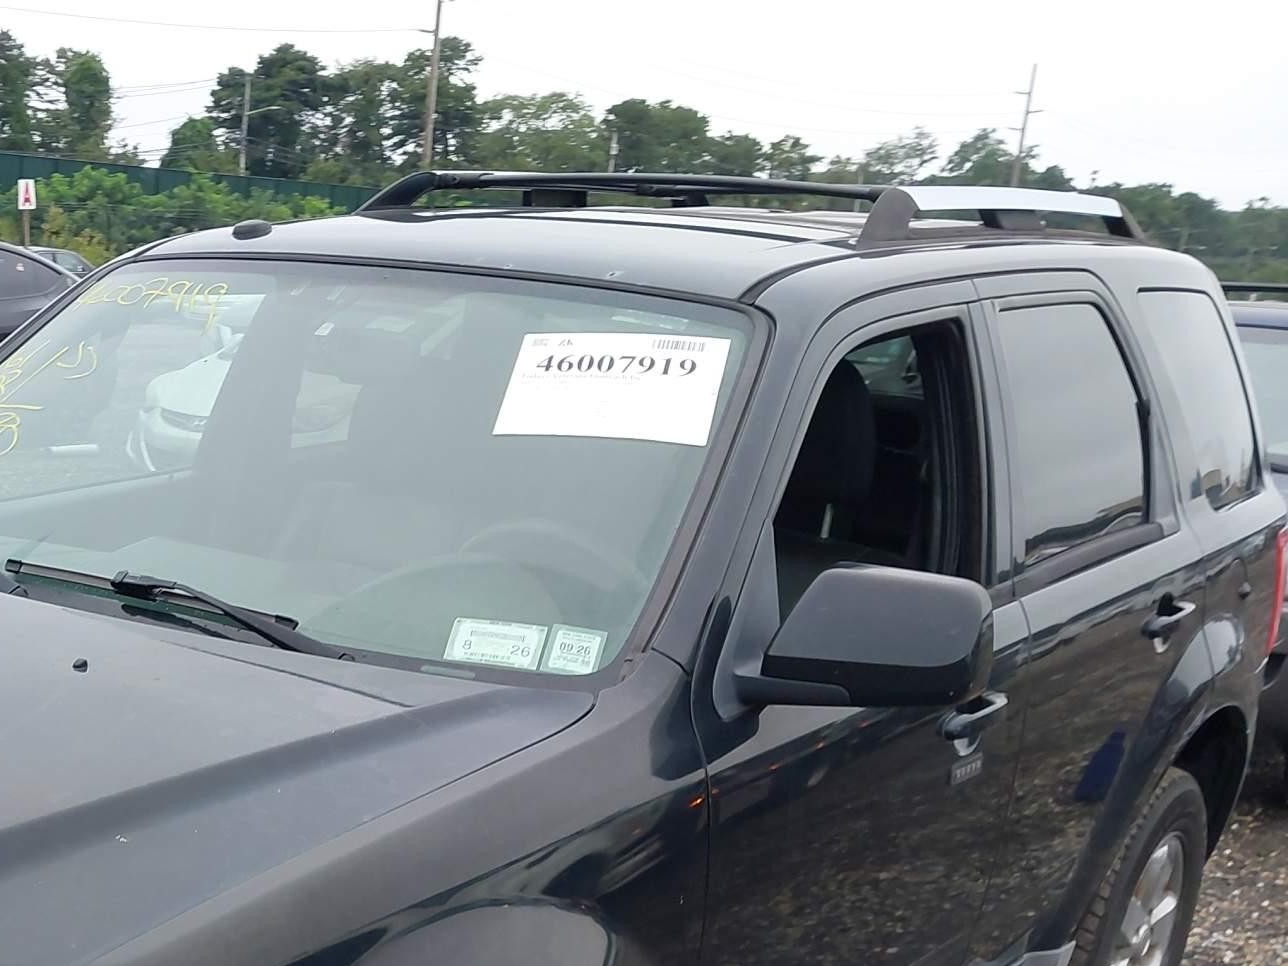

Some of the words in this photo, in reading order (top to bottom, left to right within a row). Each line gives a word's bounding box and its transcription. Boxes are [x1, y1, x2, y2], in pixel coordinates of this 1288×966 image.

[22, 181, 33, 206] A
[536, 353, 698, 377] 46007919
[510, 645, 531, 657] 26
